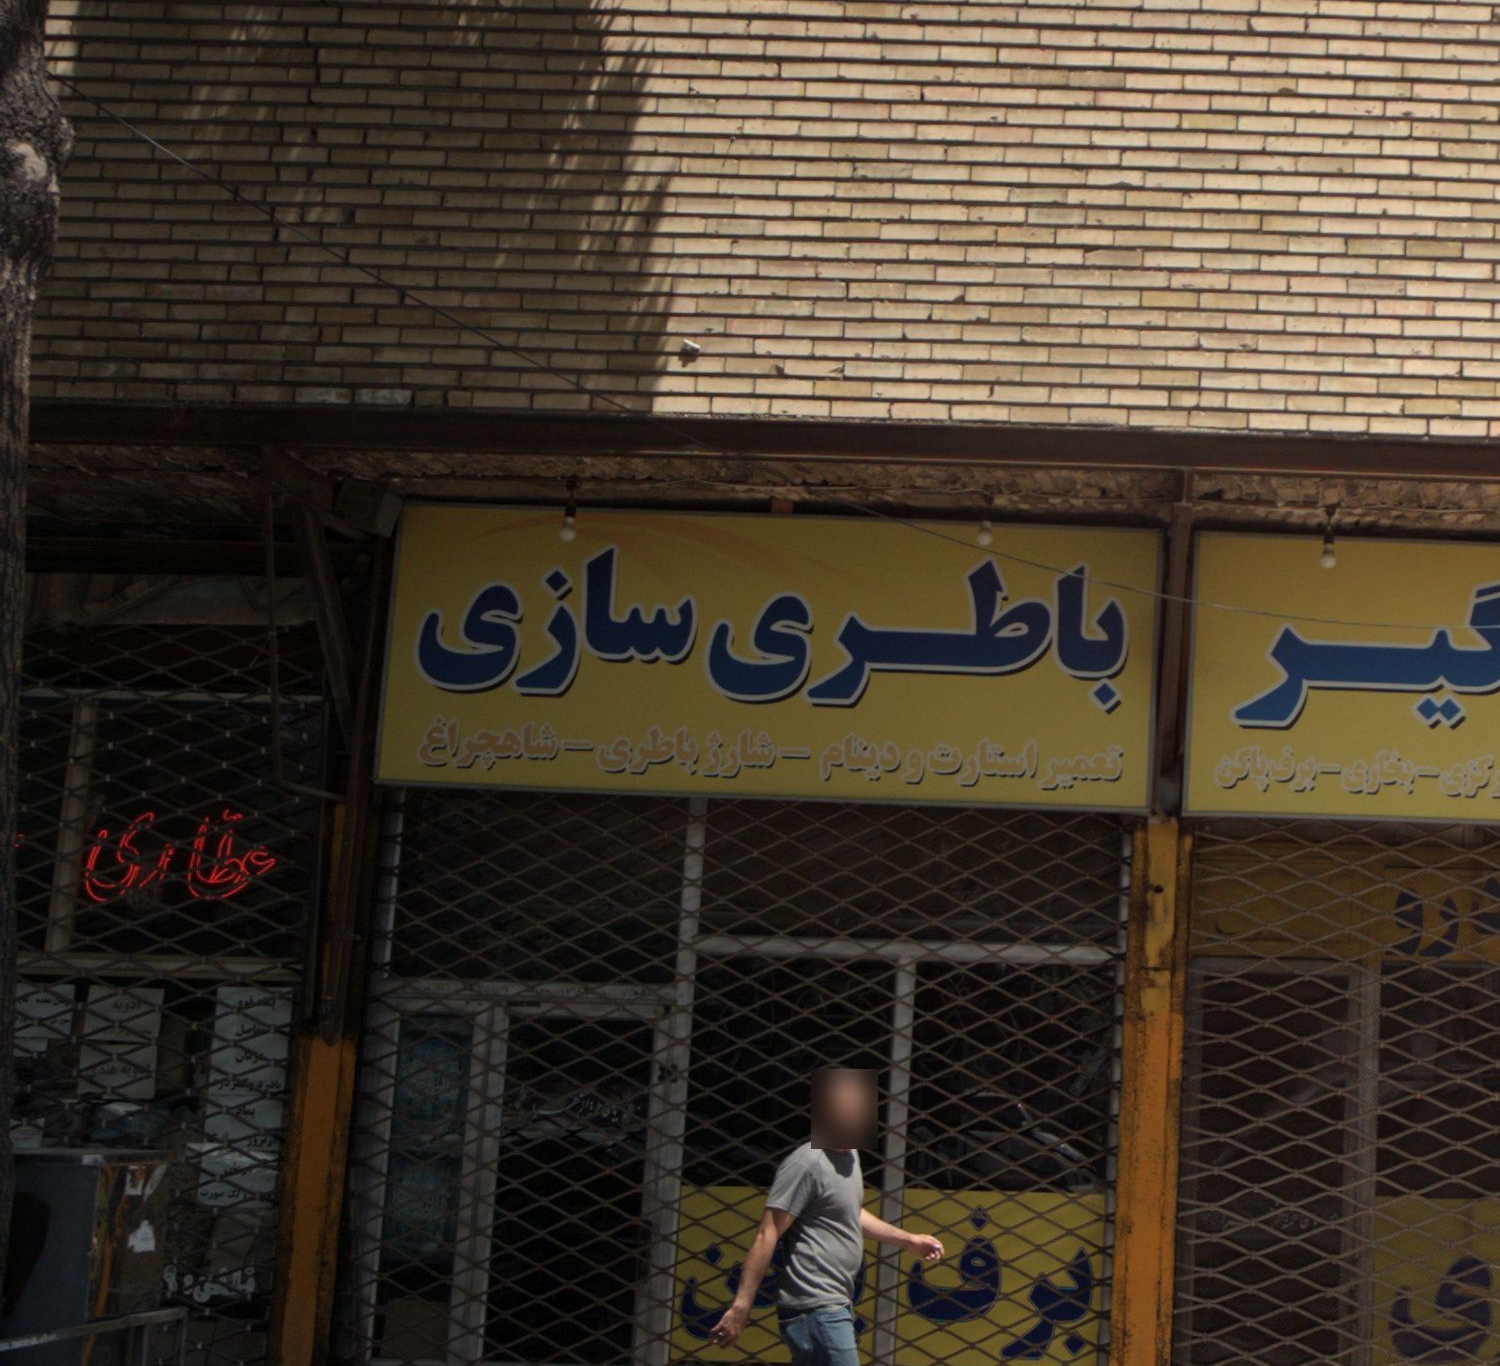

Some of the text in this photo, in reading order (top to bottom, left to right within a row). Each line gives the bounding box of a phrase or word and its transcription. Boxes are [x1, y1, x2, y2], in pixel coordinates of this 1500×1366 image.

[414, 544, 1130, 712] باطری سازی
[416, 714, 1125, 790] تعمیر استارت و دینام شارژ باطری شاهچراغ
[906, 1204, 1096, 1361] برف
